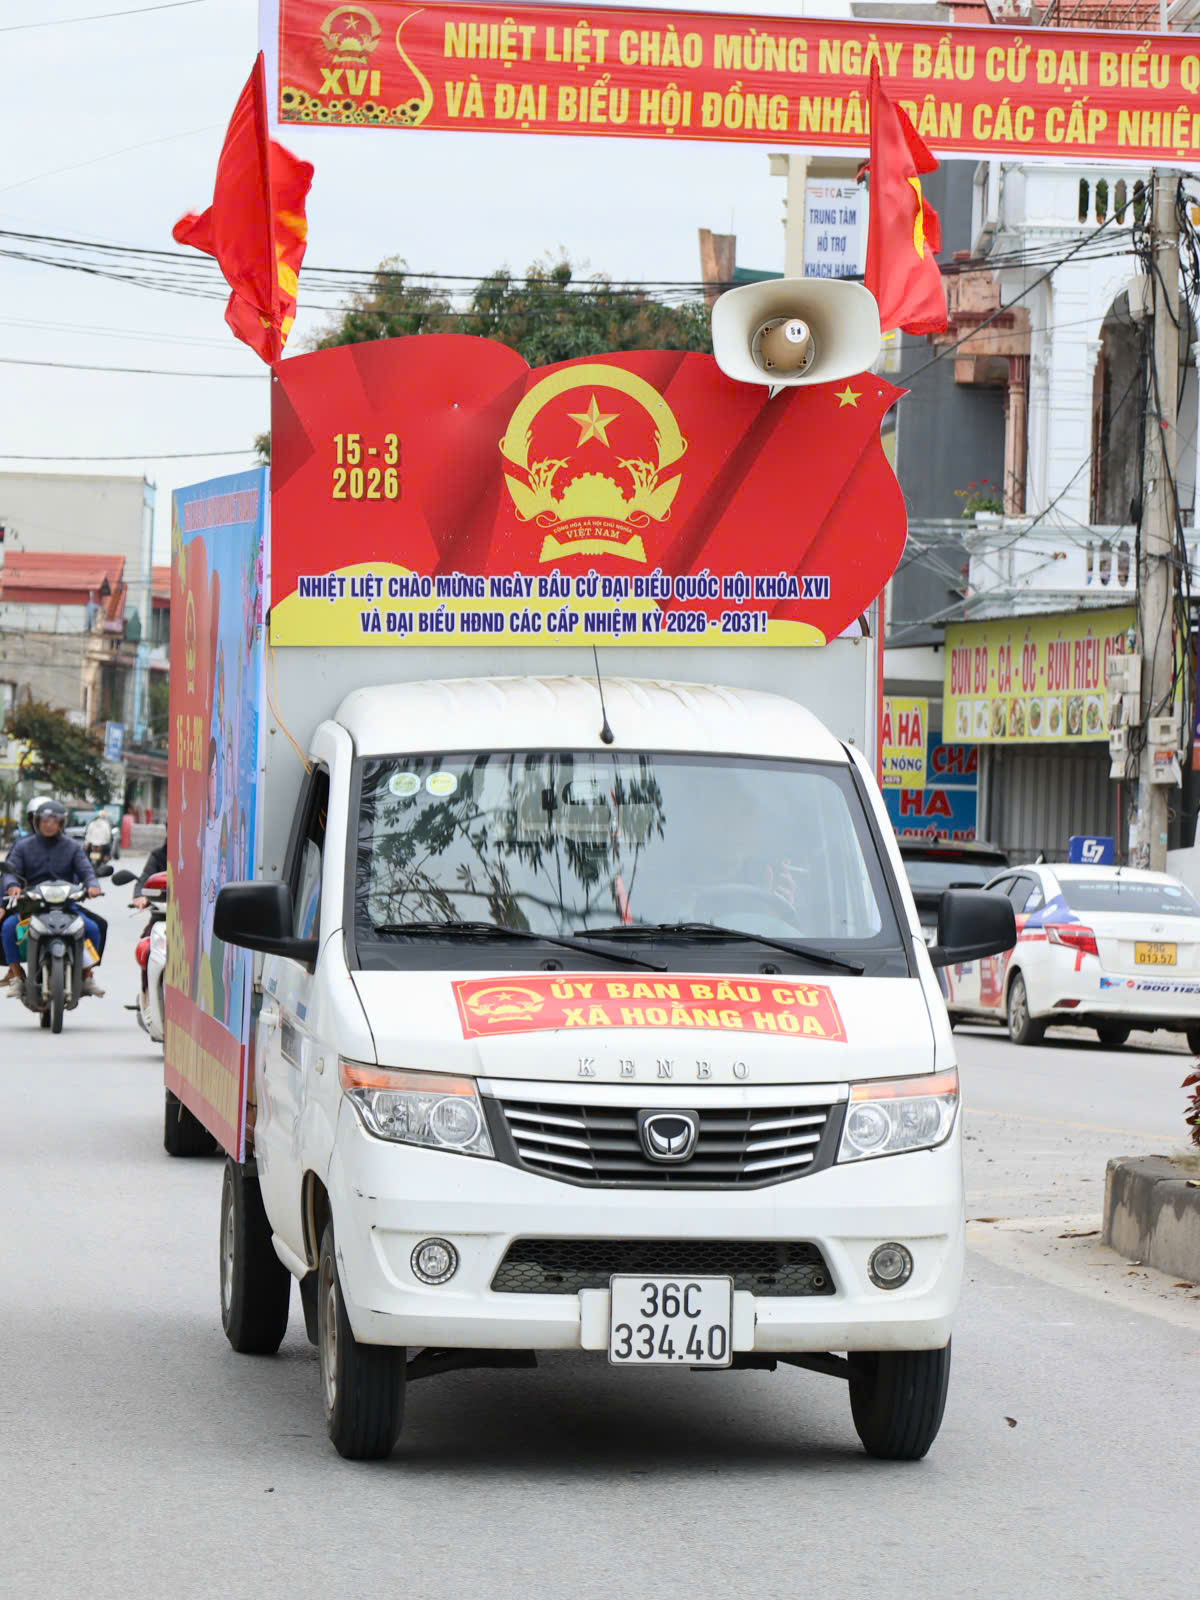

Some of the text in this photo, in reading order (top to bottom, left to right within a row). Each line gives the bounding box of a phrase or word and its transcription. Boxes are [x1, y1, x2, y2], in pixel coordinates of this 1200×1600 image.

[444, 17, 536, 68] NHIỆT
[546, 20, 610, 71] LIỆT
[619, 24, 703, 68] CHÀO
[713, 27, 808, 73] MỪNG
[818, 33, 904, 77] NGÀY
[913, 32, 976, 80] BẦU
[985, 36, 1031, 83] CỬ
[1036, 49, 1089, 93] ĐẠI
[1099, 39, 1170, 89] BIỂU
[318, 68, 381, 97] XVI
[444, 73, 485, 119] VÀ
[495, 83, 548, 128] ĐẠI
[557, 72, 630, 124] BIỂU
[639, 82, 692, 134] HỘI
[701, 80, 789, 131] ĐỒNG
[798, 89, 871, 134] NHÂ
[973, 97, 1035, 142] CÁC
[1045, 96, 1108, 144] CẤP
[810, 206, 856, 225] TRUNG TÂM
[334, 433, 361, 465] 15
[384, 433, 398, 465] 3
[332, 467, 399, 499] 2026
[566, 528, 620, 539] VIỆT NAM
[299, 568, 830, 602] NHIỆT LIỆT CHÀO MỪNG NGÀY BẦU CỬ ĐẠI BIỂU QUỐC HỘI KHÓA XVI
[361, 608, 382, 632] VÀ
[386, 612, 413, 637] ĐẠI
[418, 604, 456, 632] BIỂU
[460, 612, 505, 632] HĐND
[509, 607, 542, 632] CÁC
[547, 605, 580, 632] CẤP
[584, 608, 637, 637] NHIỆM
[642, 608, 663, 632] KỲ
[666, 612, 706, 633] 2026
[721, 612, 767, 633] 2031!
[951, 638, 972, 695] BÚN
[974, 633, 988, 694] BÒ
[998, 631, 1011, 693] CÁ
[1022, 624, 1037, 692] ỐC
[1047, 630, 1071, 691] BÚN
[550, 978, 821, 1007] ỦY BAN BẦU CỬ
[563, 1001, 826, 1036] XÃ HOẰNG HÓA
[578, 1056, 751, 1080] KENBO
[640, 1282, 702, 1318] 36C
[614, 1323, 727, 1360] 334.40
